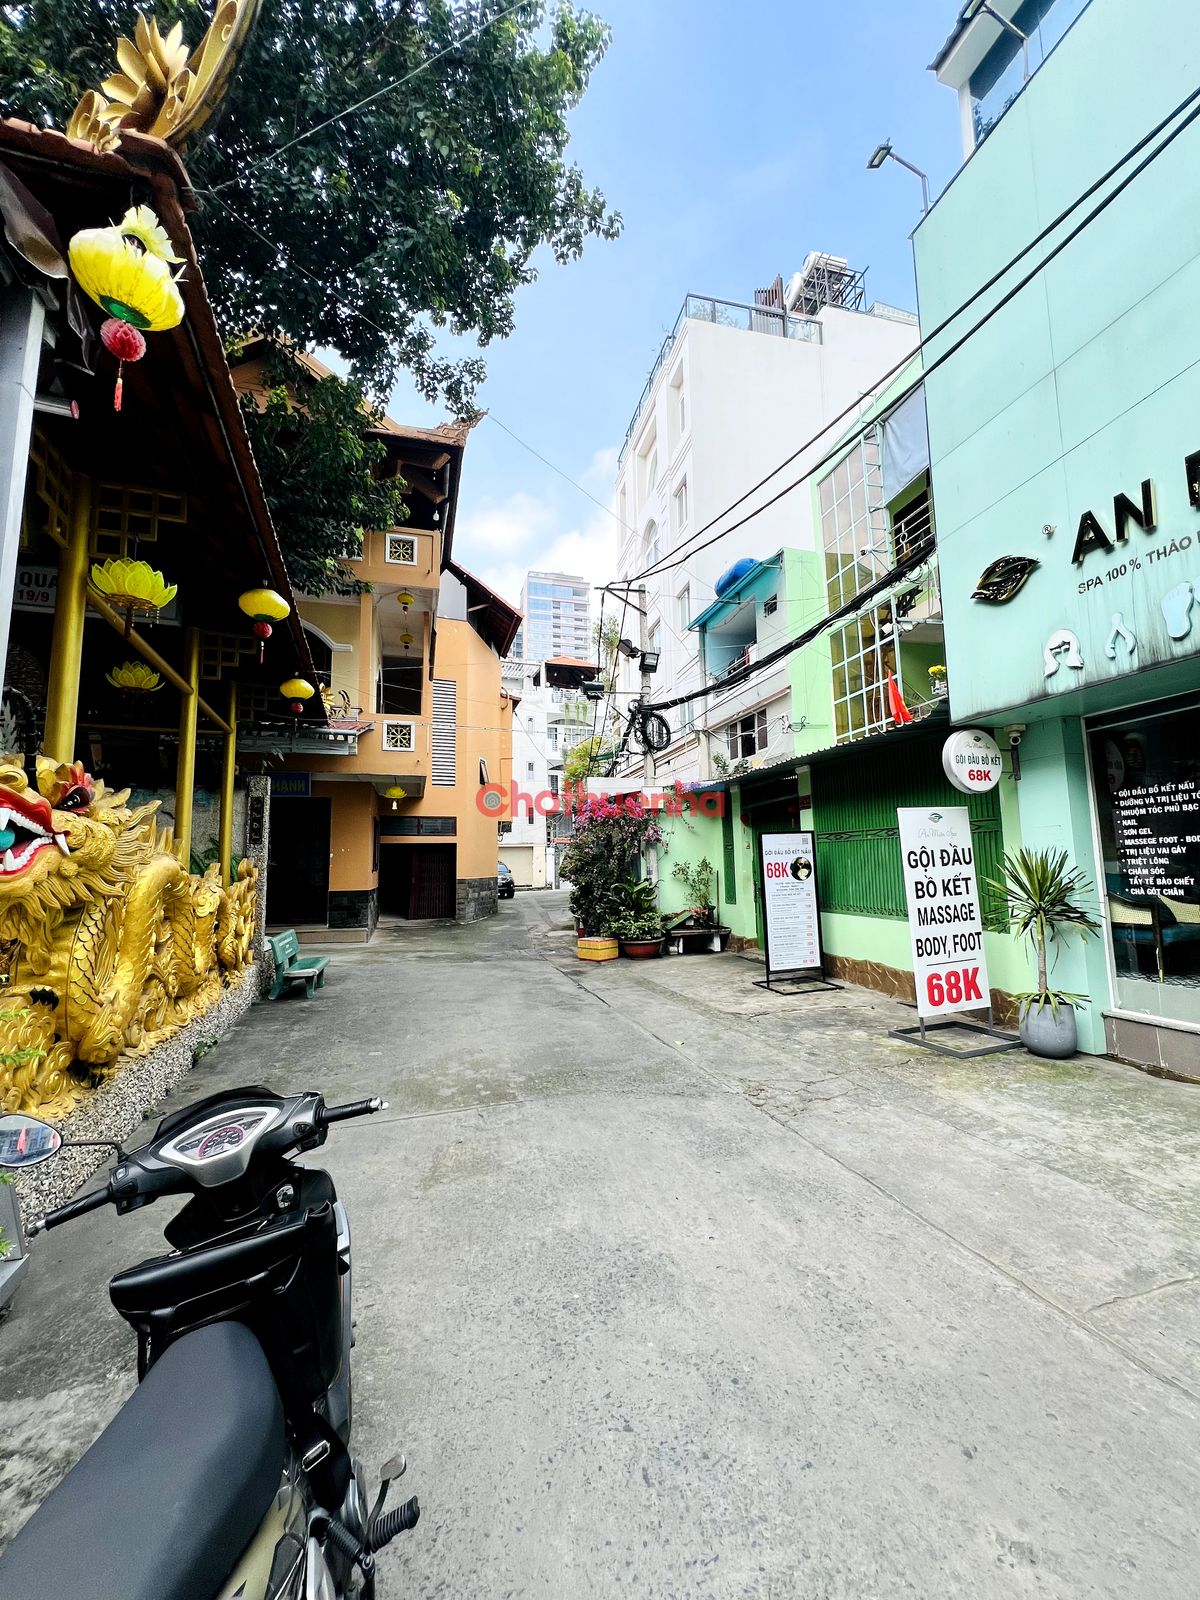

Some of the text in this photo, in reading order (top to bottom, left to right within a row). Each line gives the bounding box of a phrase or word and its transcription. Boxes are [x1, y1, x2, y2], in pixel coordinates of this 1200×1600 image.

[1071, 478, 1157, 567] AN
[1078, 576, 1103, 594] SPA
[1146, 535, 1192, 564] THẢO
[17, 590, 50, 602] 19/9
[968, 769, 992, 781] 68K
[1144, 796, 1155, 804] VÀ
[1171, 792, 1189, 802] LIỆU
[1148, 806, 1163, 814] TÓC
[1164, 802, 1180, 812] PHỦ
[1182, 803, 1199, 812] BẠC
[1123, 827, 1152, 836] SƠN GEL
[1124, 837, 1157, 845] MASSEGE
[1139, 846, 1155, 855] LIỆU
[907, 843, 973, 872] GỘI ĐẦU
[766, 862, 789, 878] 68K
[1150, 866, 1165, 874] SÓC
[914, 872, 971, 899] BỒ KẾT
[1144, 876, 1155, 885] TẾ
[1156, 876, 1172, 885] BÀO
[1173, 876, 1195, 885] CHẾT
[1146, 886, 1161, 895] GÓT
[917, 903, 976, 926] MASSAGE
[915, 931, 982, 958] BODY, FOOT
[926, 967, 983, 1007] 68K
